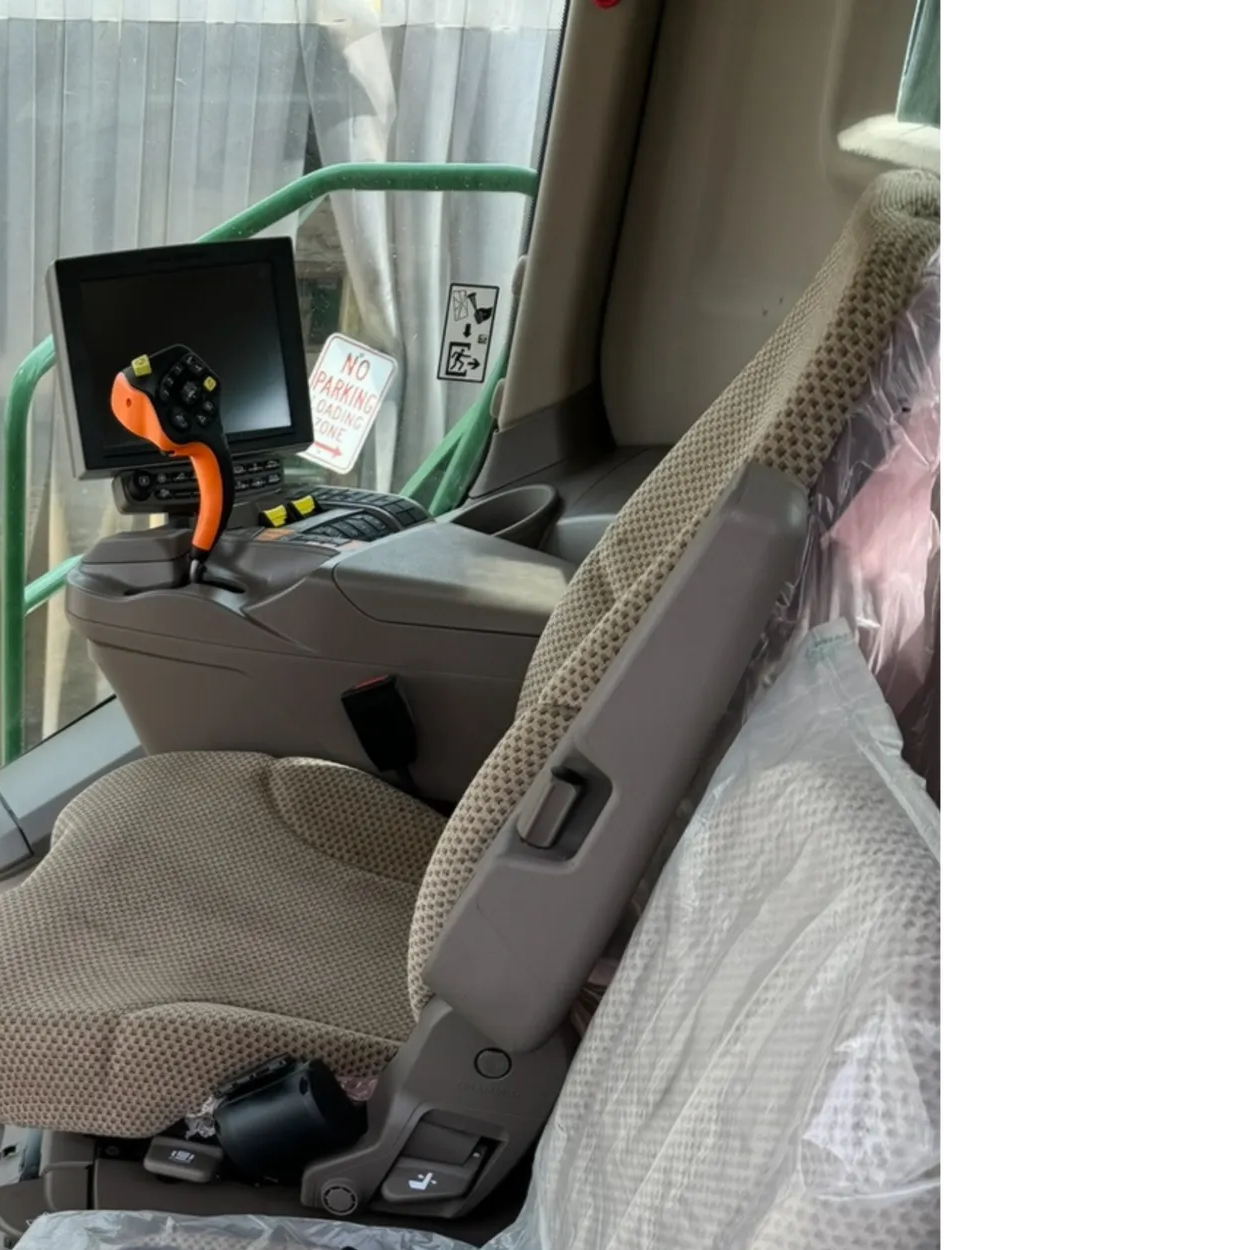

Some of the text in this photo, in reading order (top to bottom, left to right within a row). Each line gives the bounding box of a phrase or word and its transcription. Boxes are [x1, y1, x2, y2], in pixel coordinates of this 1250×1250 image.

[341, 353, 371, 381] NO
[314, 371, 378, 414] PARKING
[314, 396, 365, 430] OADING
